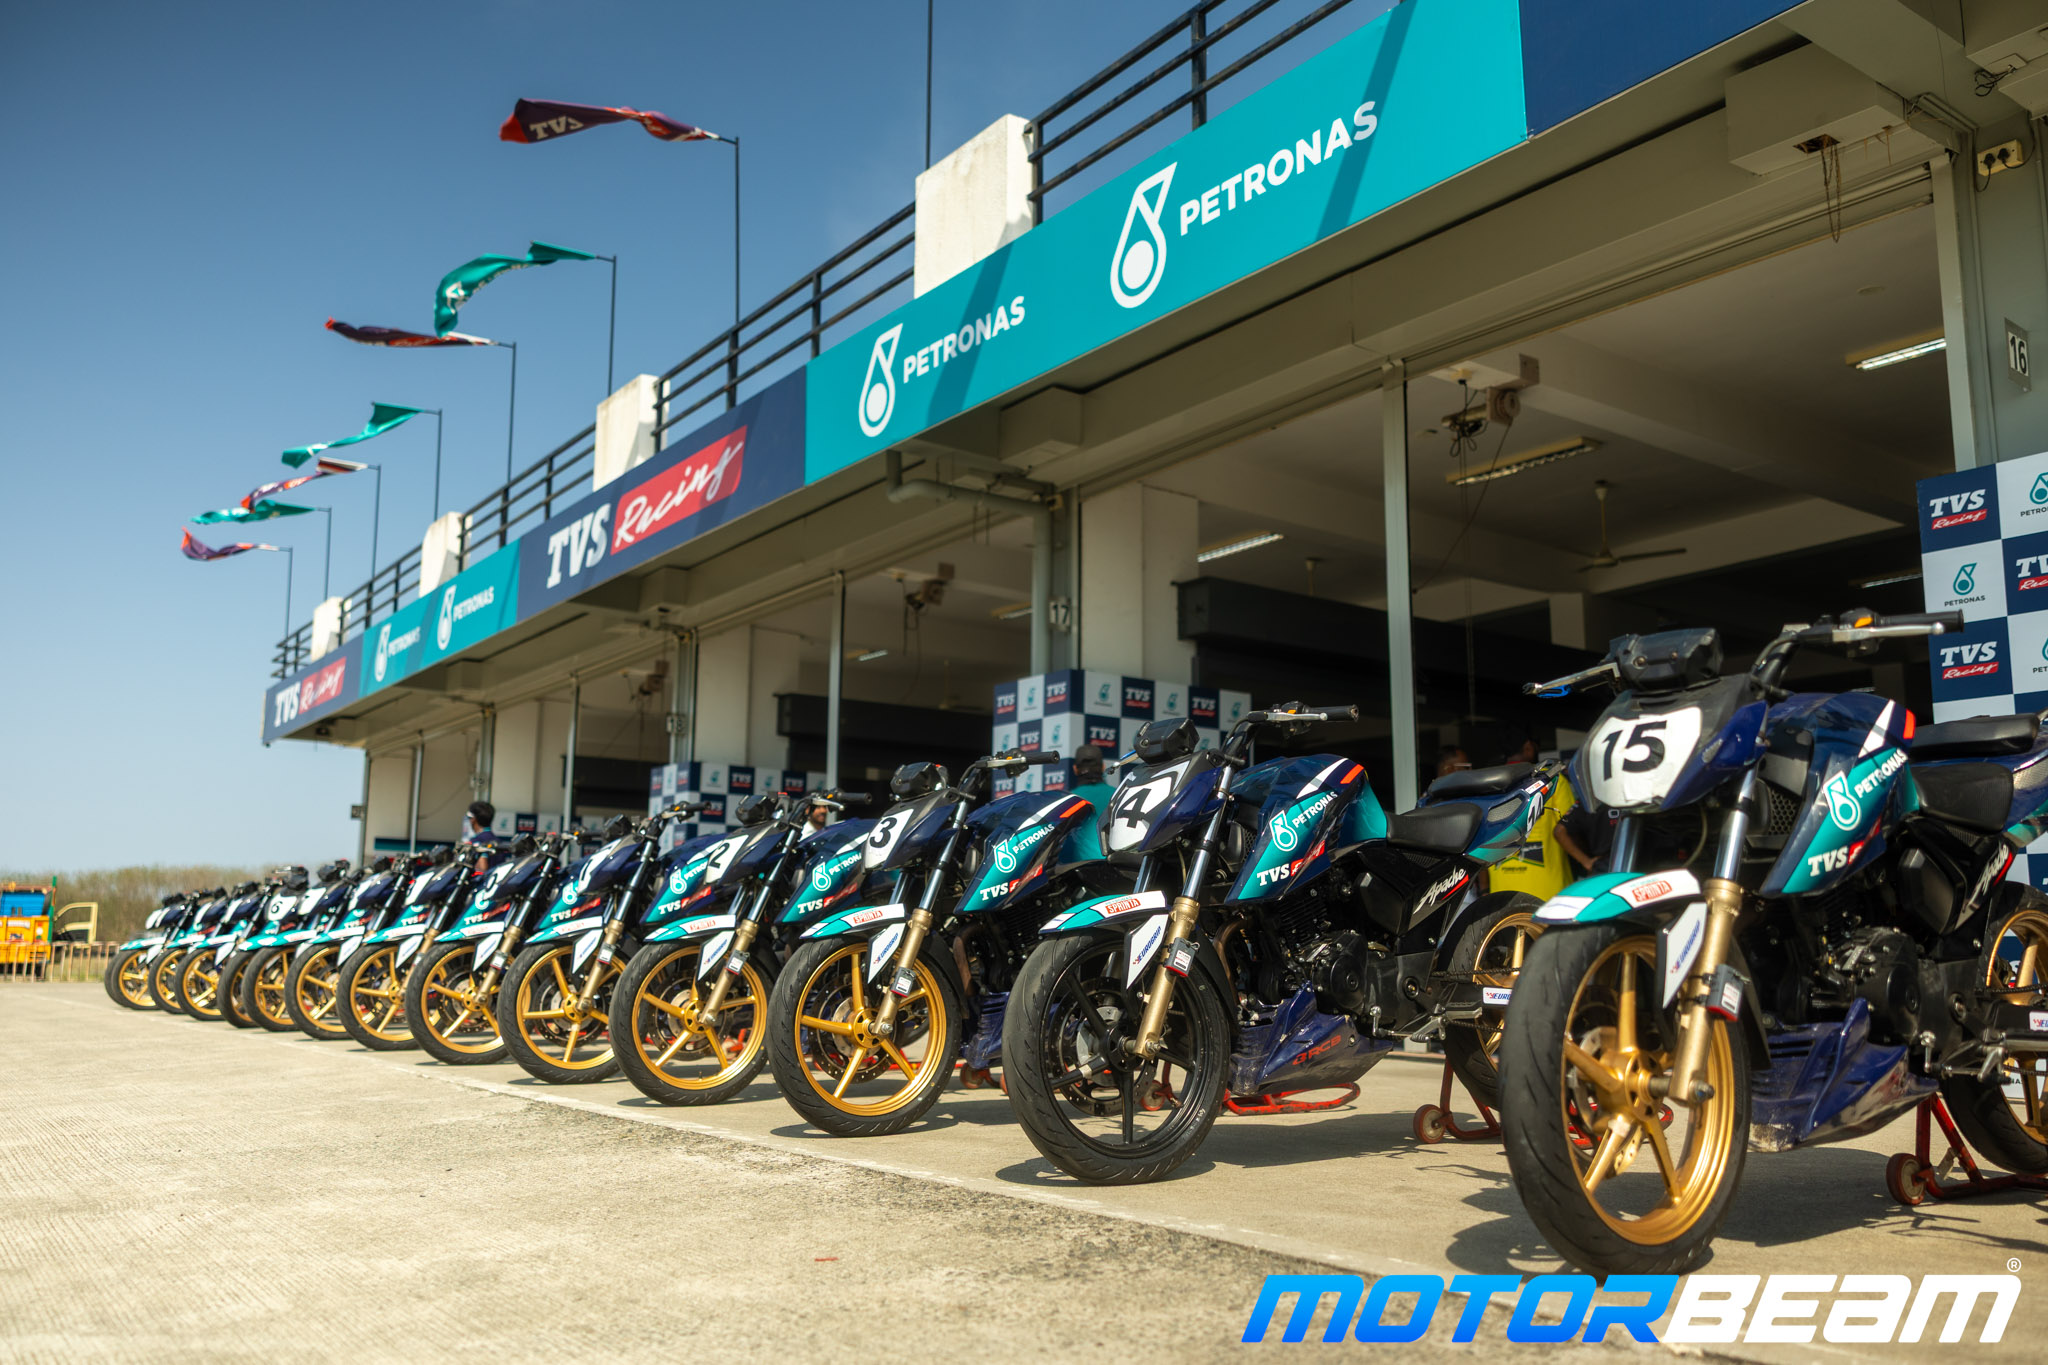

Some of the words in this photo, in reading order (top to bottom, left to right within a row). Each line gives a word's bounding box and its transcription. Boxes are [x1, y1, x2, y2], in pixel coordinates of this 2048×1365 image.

[1180, 101, 1377, 236] PETRONAS
[902, 296, 1026, 383] PETRONAS
[2010, 334, 2028, 376] 16
[546, 503, 611, 588] TVS
[614, 442, 744, 550] Racing
[1929, 489, 1986, 518] TVS
[2020, 506, 2048, 517] PETRO
[1932, 510, 1986, 529] Racing
[452, 587, 495, 621] PETRONAS
[1944, 595, 1986, 607] PETRONAS
[1053, 604, 1069, 625] 17
[1940, 641, 1998, 667] TVS
[1943, 662, 1999, 680] Racing
[1047, 682, 1067, 696] TVS
[1125, 687, 1151, 701] TVS
[274, 686, 301, 727] TVS
[1192, 697, 1216, 710] TVS
[1090, 727, 1116, 741] TVS
[1602, 720, 1668, 781] 15
[1045, 771, 1065, 784] TVS
[1854, 748, 1909, 798] PETRONAS
[1292, 791, 1339, 828] PETRONAS
[870, 817, 897, 848] 3
[1012, 824, 1055, 854] PETRONAS
[709, 842, 730, 869] 2
[1808, 846, 1849, 877] TVS
[1257, 863, 1290, 886] TVS
[980, 882, 1009, 900] TVS
[1413, 865, 1467, 914] Apache
[1632, 880, 1673, 902] SPRINTA
[551, 909, 571, 922] TVS
[658, 900, 681, 914] TVS
[798, 899, 823, 914] TVS
[1105, 898, 1141, 915] SPRINTA
[463, 914, 484, 926] TVS
[1138, 926, 1161, 961] EUROGRIP
[1308, 1035, 1341, 1060] RCB
